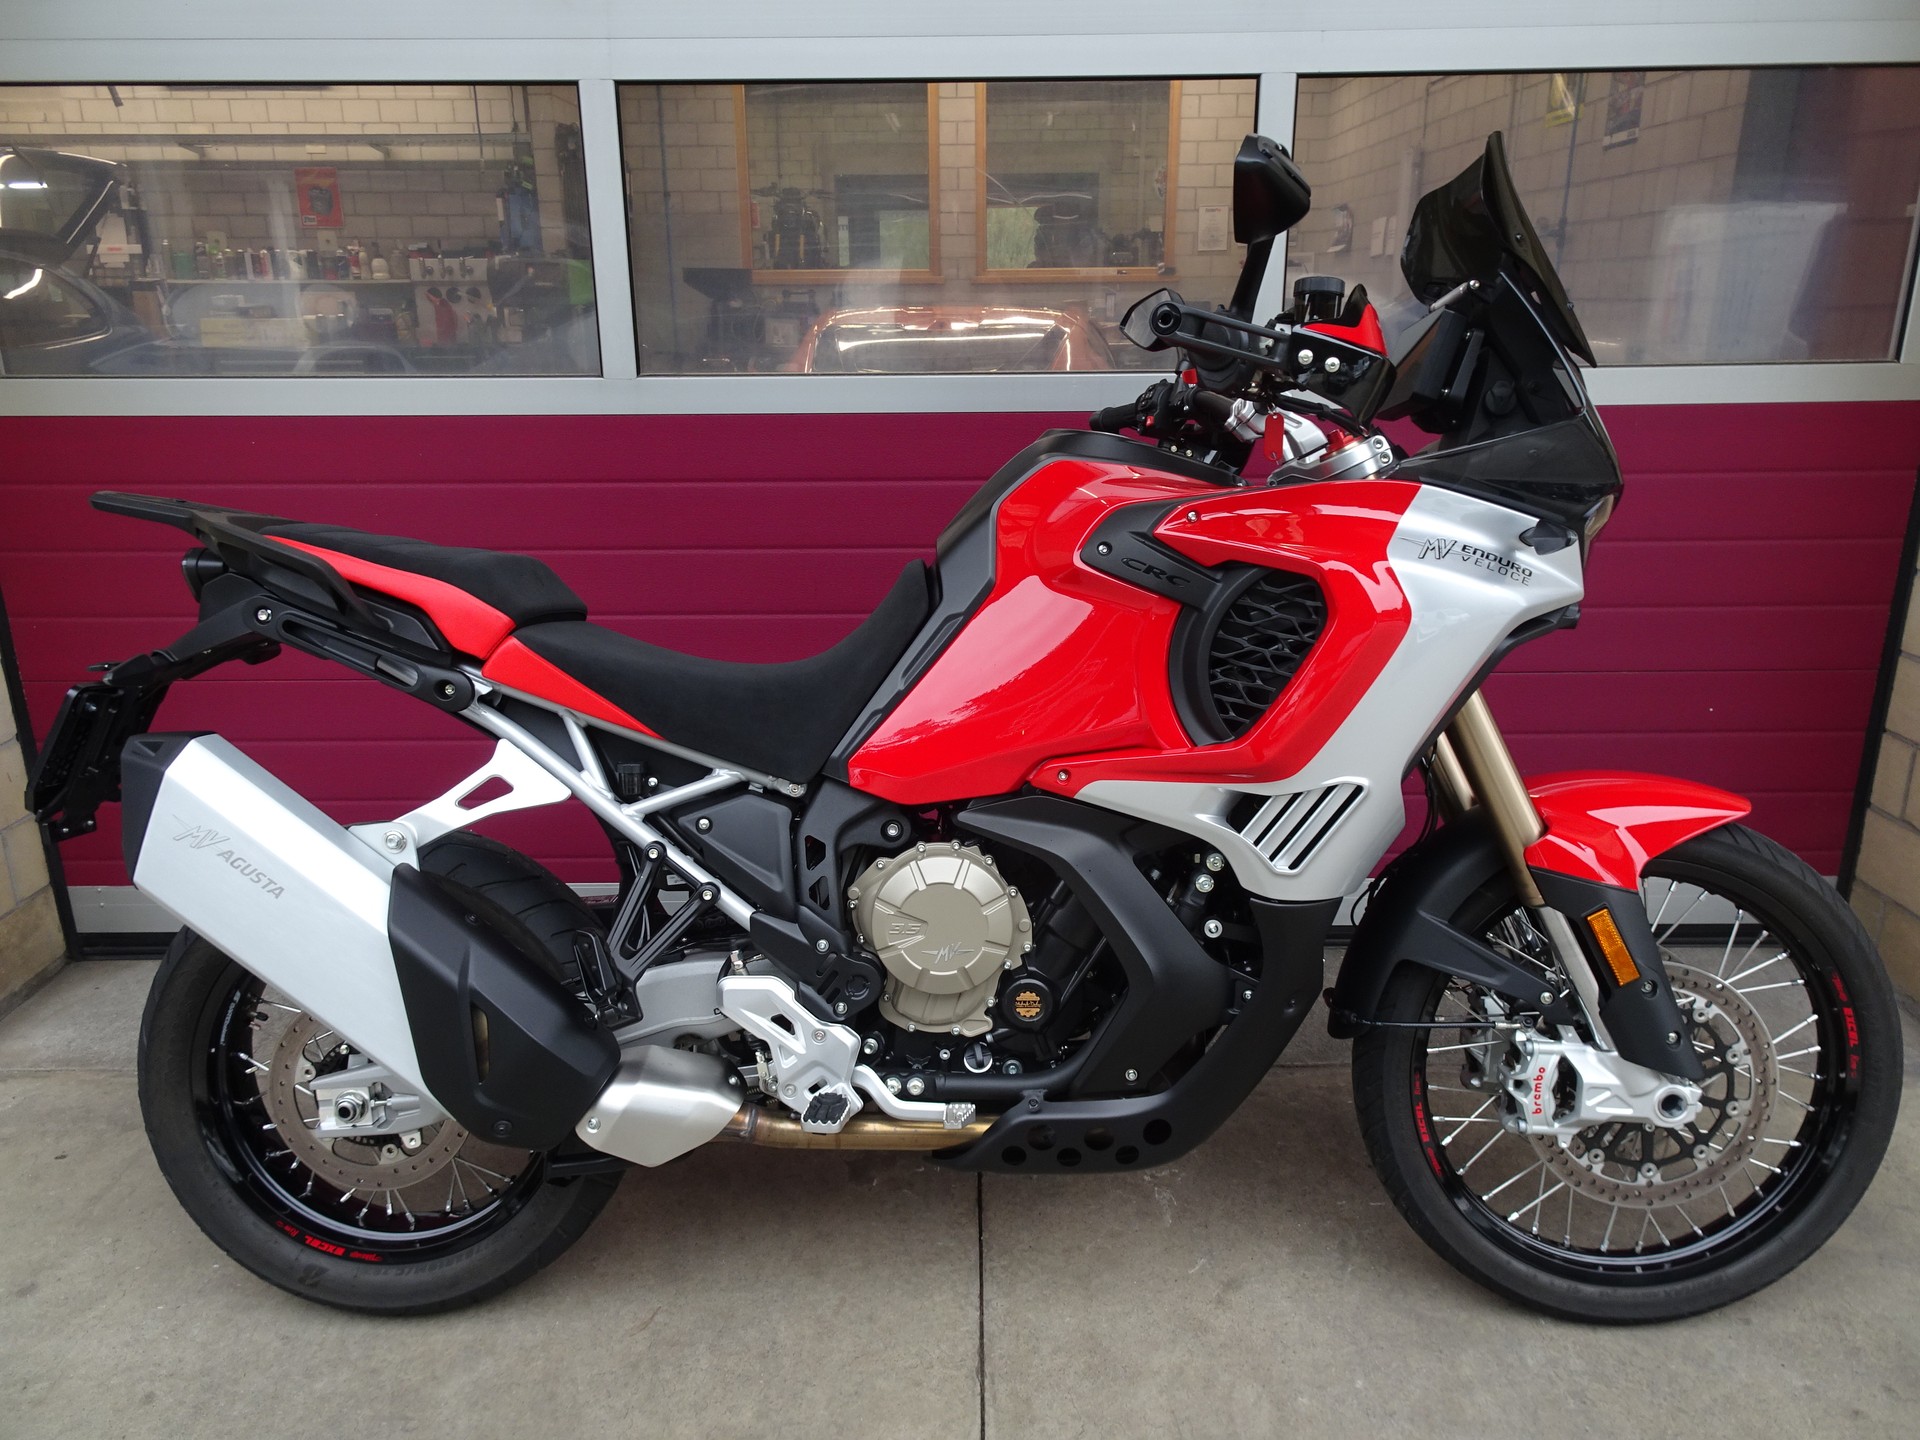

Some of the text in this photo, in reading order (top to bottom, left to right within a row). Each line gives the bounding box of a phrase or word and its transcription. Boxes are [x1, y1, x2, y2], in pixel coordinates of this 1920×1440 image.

[1121, 557, 1191, 588] CRC
[1460, 543, 1533, 578] ENDURO
[1461, 555, 1531, 587] VELOCE
[216, 849, 285, 900] AGUSTA
[1532, 1066, 1546, 1115] brembo
[304, 1234, 346, 1257] EXCEL
